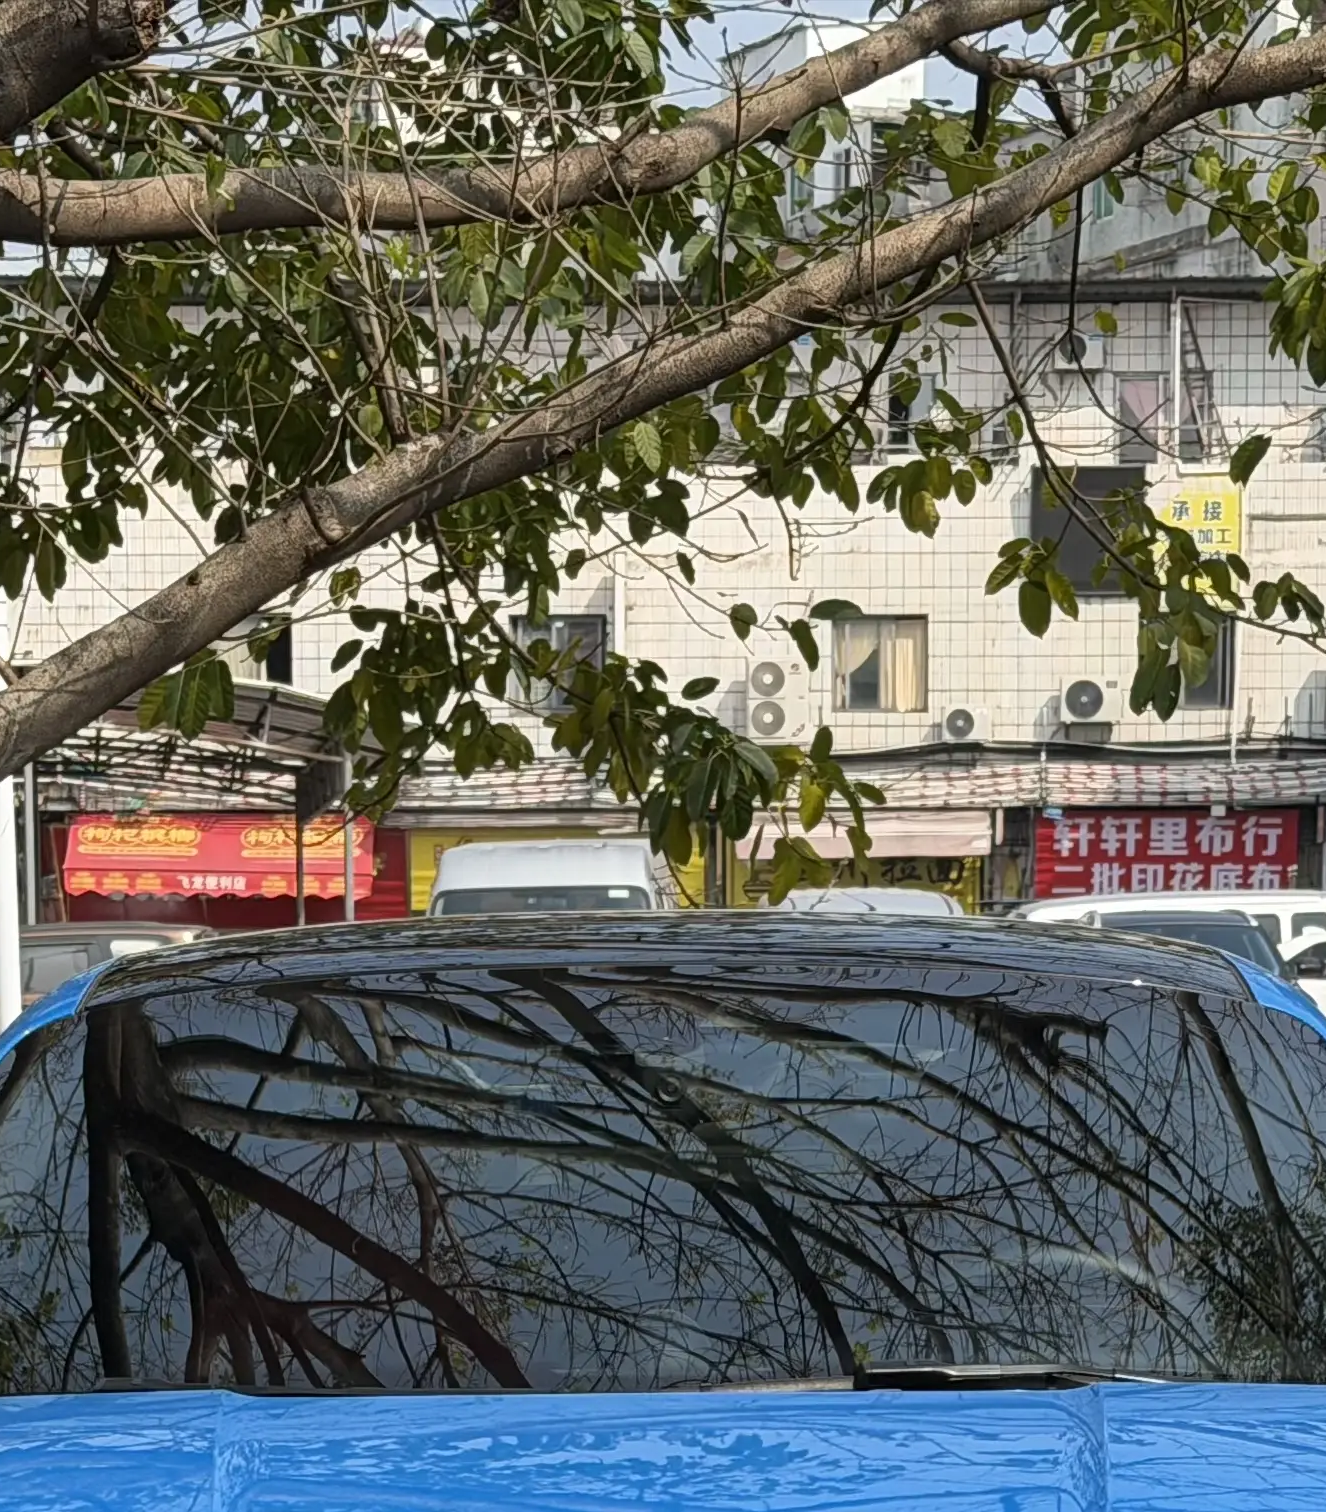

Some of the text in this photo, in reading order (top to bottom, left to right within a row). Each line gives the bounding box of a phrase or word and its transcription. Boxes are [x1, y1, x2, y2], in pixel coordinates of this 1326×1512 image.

[1171, 500, 1222, 521] 承接
[1052, 816, 1283, 857] 轩轩里布行
